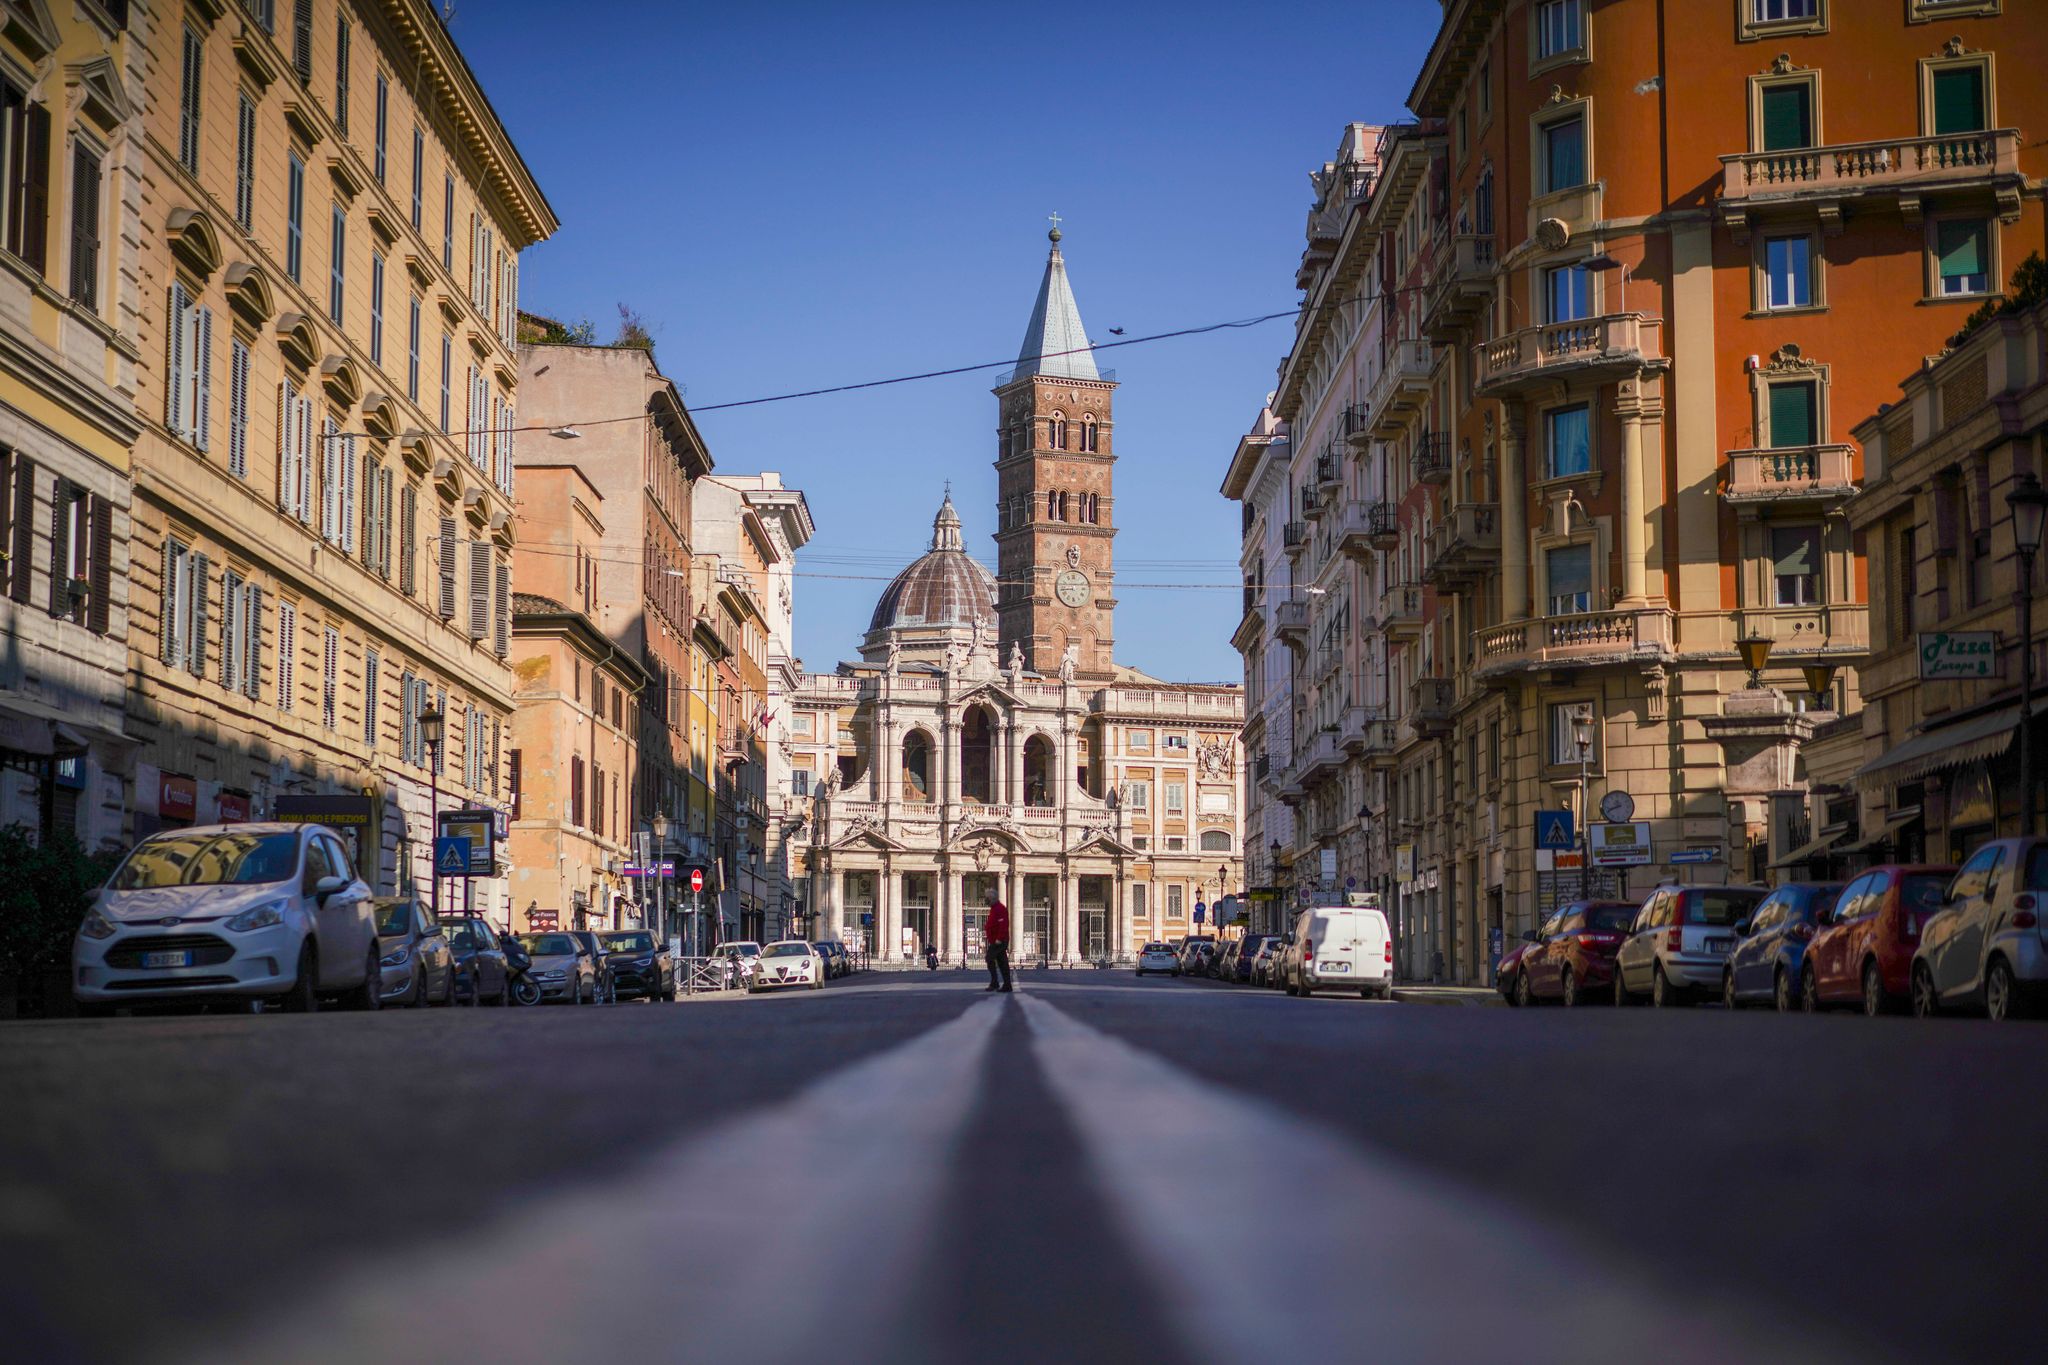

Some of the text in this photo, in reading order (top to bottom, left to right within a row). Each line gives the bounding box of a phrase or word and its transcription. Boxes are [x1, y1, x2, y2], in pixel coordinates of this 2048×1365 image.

[1923, 633, 1991, 662] Pizza
[1928, 660, 1975, 676] Europa
[280, 814, 368, 823] ROMA ORO E PREZIOSI
